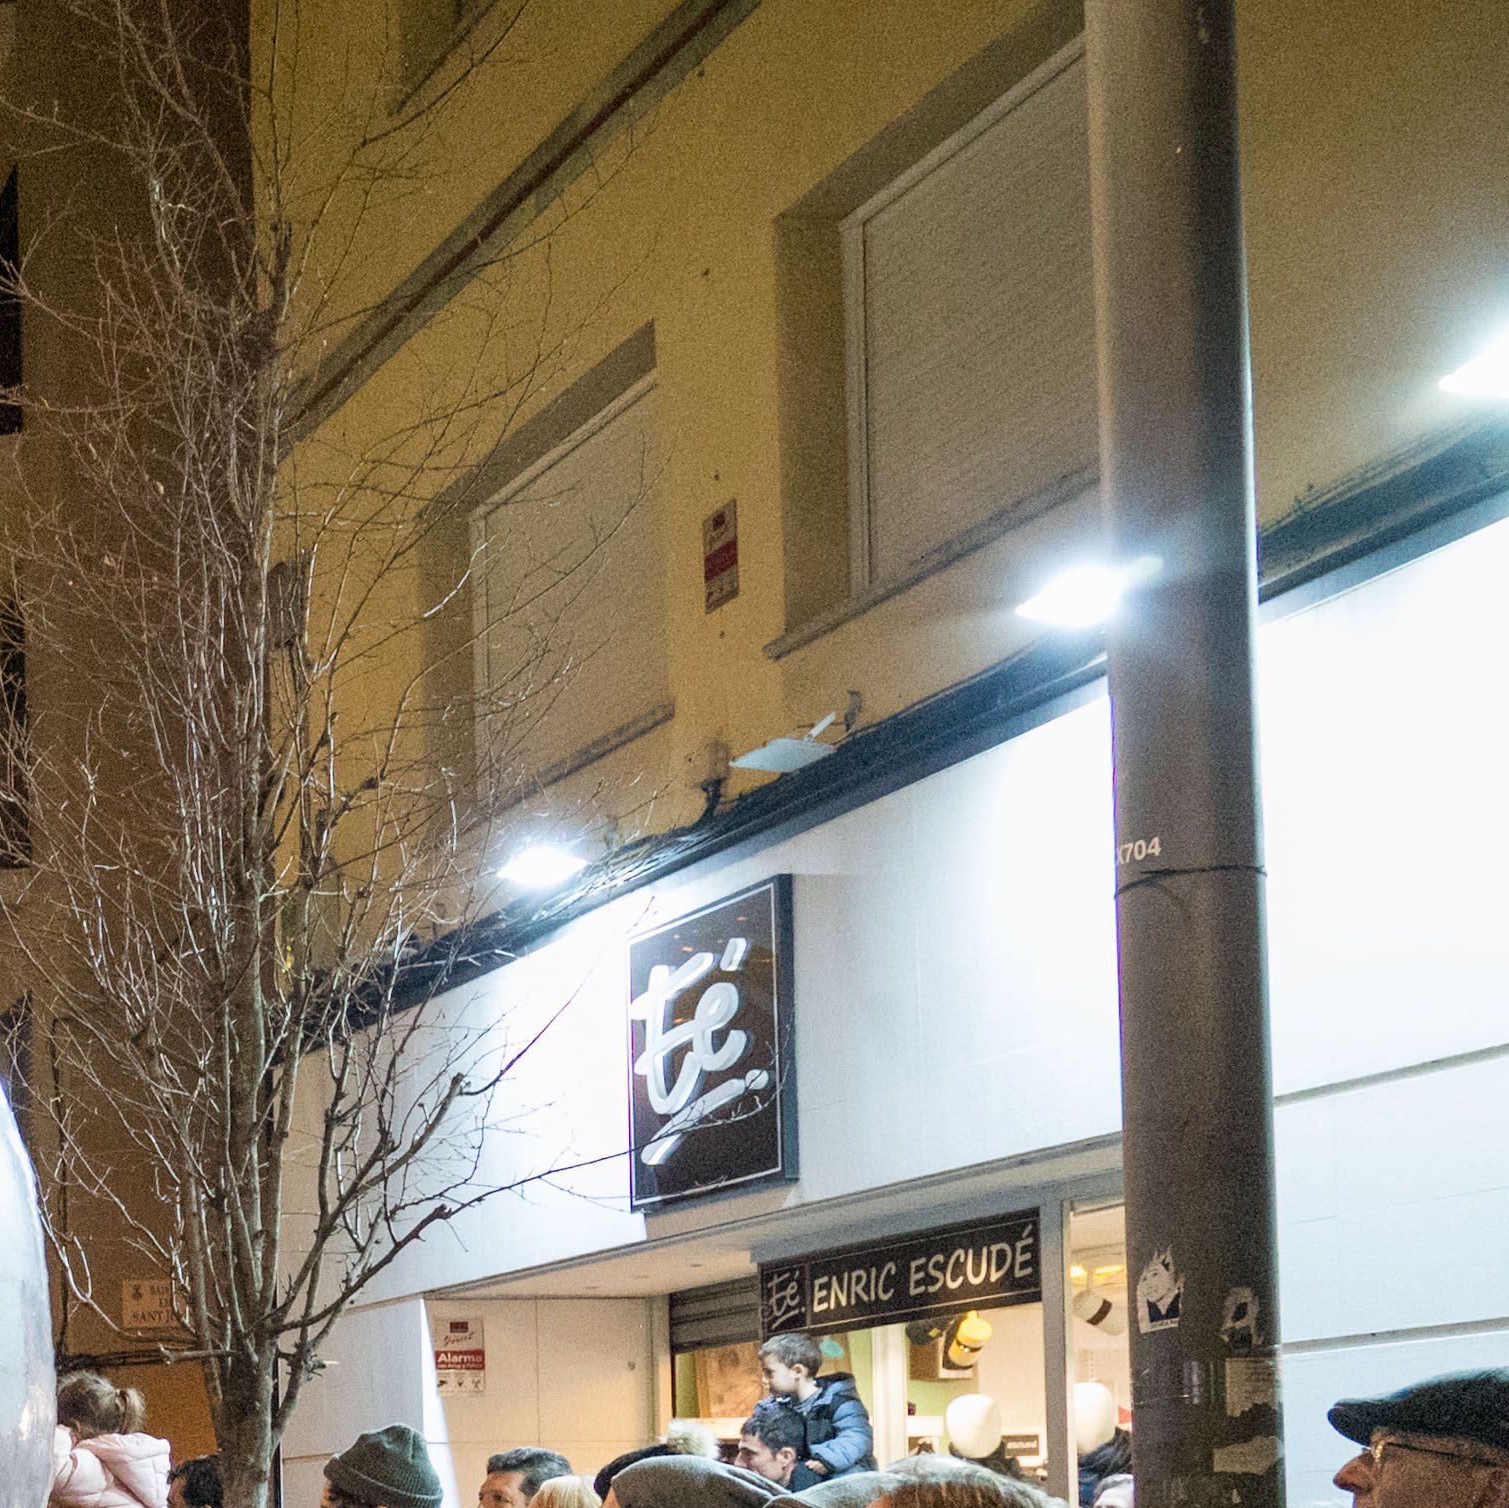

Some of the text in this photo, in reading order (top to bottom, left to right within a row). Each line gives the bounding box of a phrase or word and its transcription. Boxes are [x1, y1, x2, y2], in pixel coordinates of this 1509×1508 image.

[813, 1262, 895, 1313] ENRIC
[909, 1224, 1033, 1296] ESCUDÉ
[438, 1352, 483, 1363] Alarma
